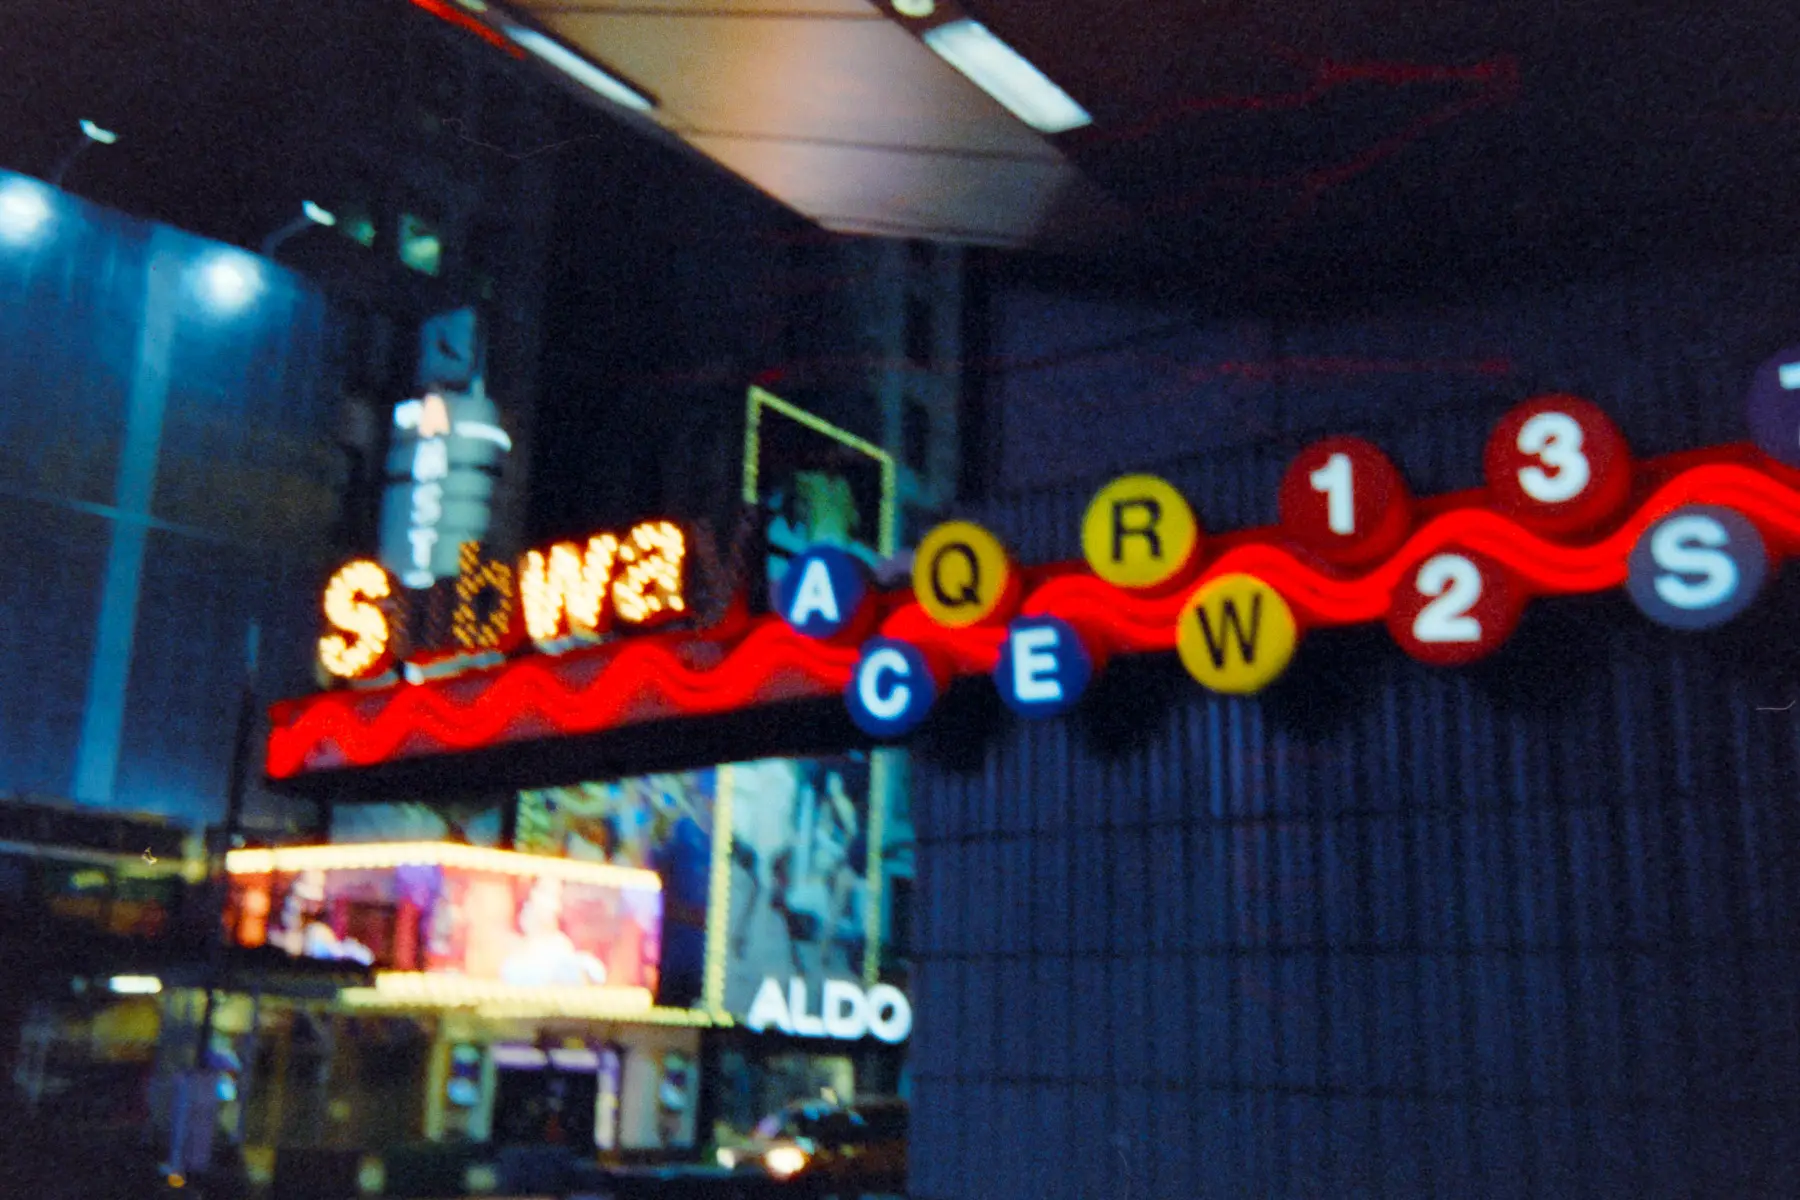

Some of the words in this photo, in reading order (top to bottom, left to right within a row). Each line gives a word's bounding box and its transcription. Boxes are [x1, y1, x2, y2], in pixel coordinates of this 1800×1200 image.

[789, 557, 840, 626] A
[930, 540, 982, 609] Q
[1109, 497, 1164, 564] R
[1310, 453, 1355, 535] 1
[1516, 411, 1590, 503] 3
[857, 647, 912, 721] C
[1010, 625, 1063, 703] E
[1194, 592, 1263, 672] W
[1412, 553, 1483, 642] 2
[1649, 514, 1740, 610] S
[746, 975, 913, 1043] ALDO
